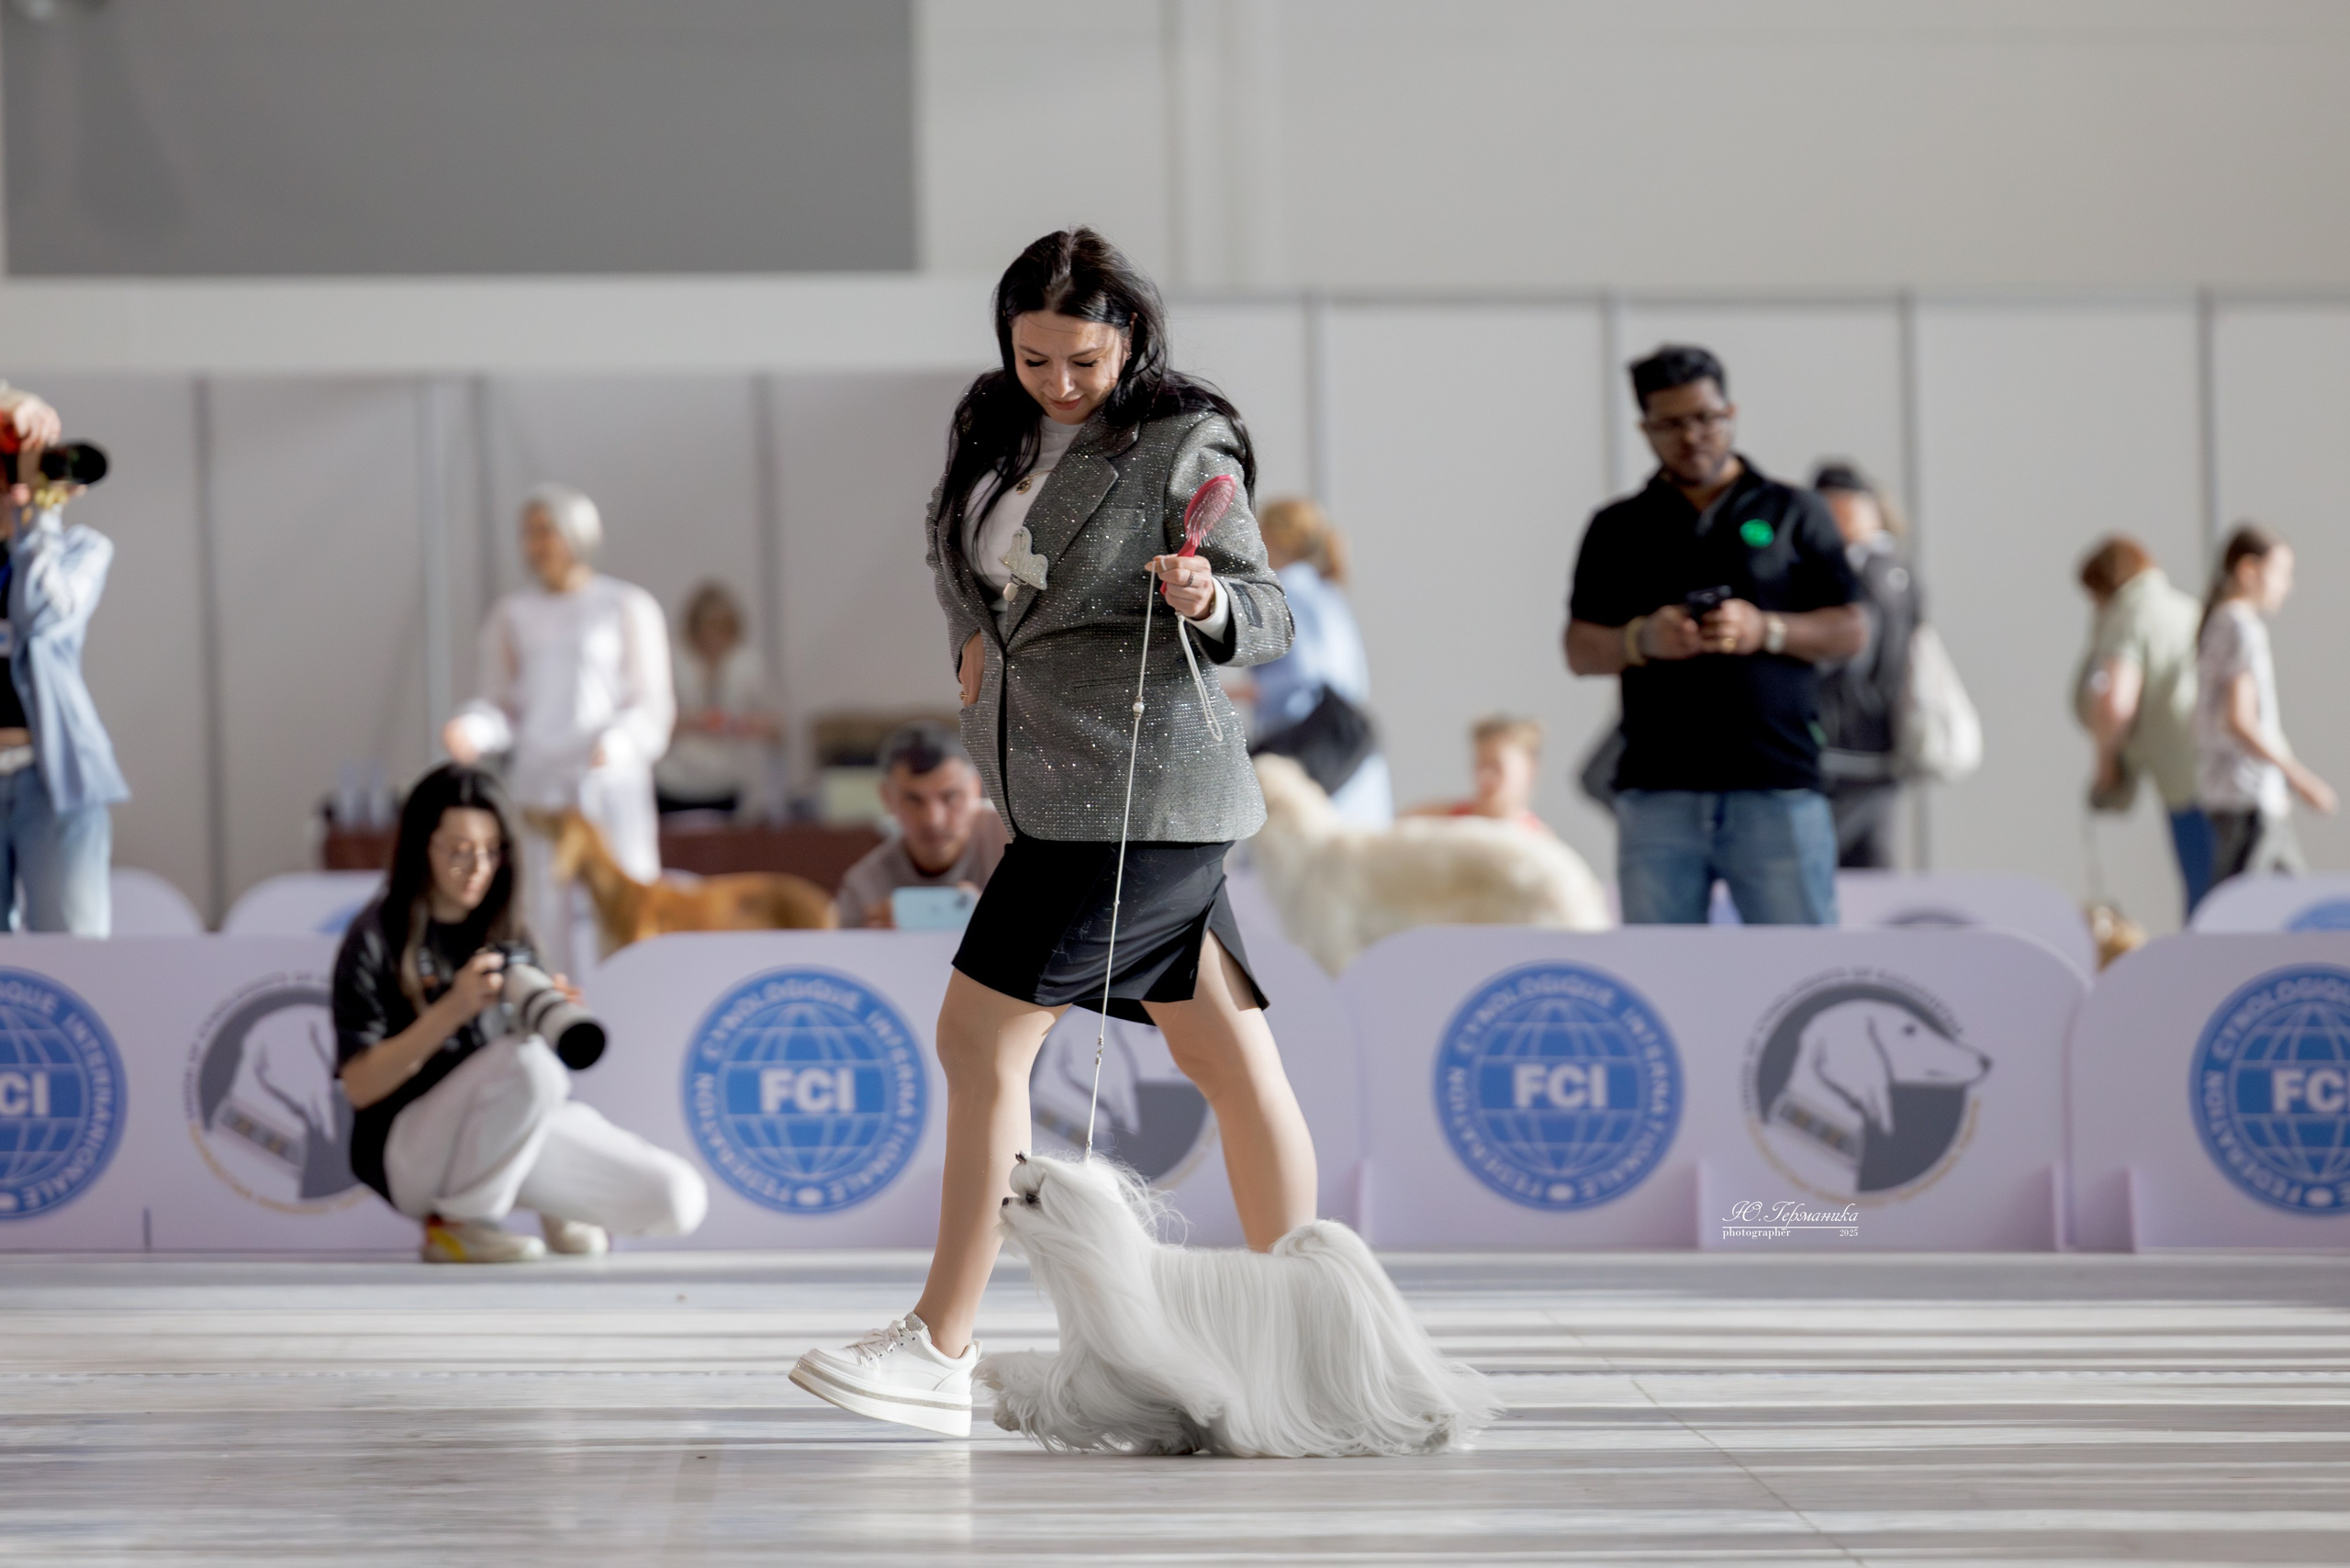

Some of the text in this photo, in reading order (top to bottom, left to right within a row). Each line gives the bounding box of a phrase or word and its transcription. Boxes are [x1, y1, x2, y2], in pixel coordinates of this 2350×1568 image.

[0, 1070, 50, 1117] CI
[760, 1068, 856, 1114] FCI
[1514, 1063, 1608, 1109] FCI
[2271, 1069, 2350, 1113] FC
